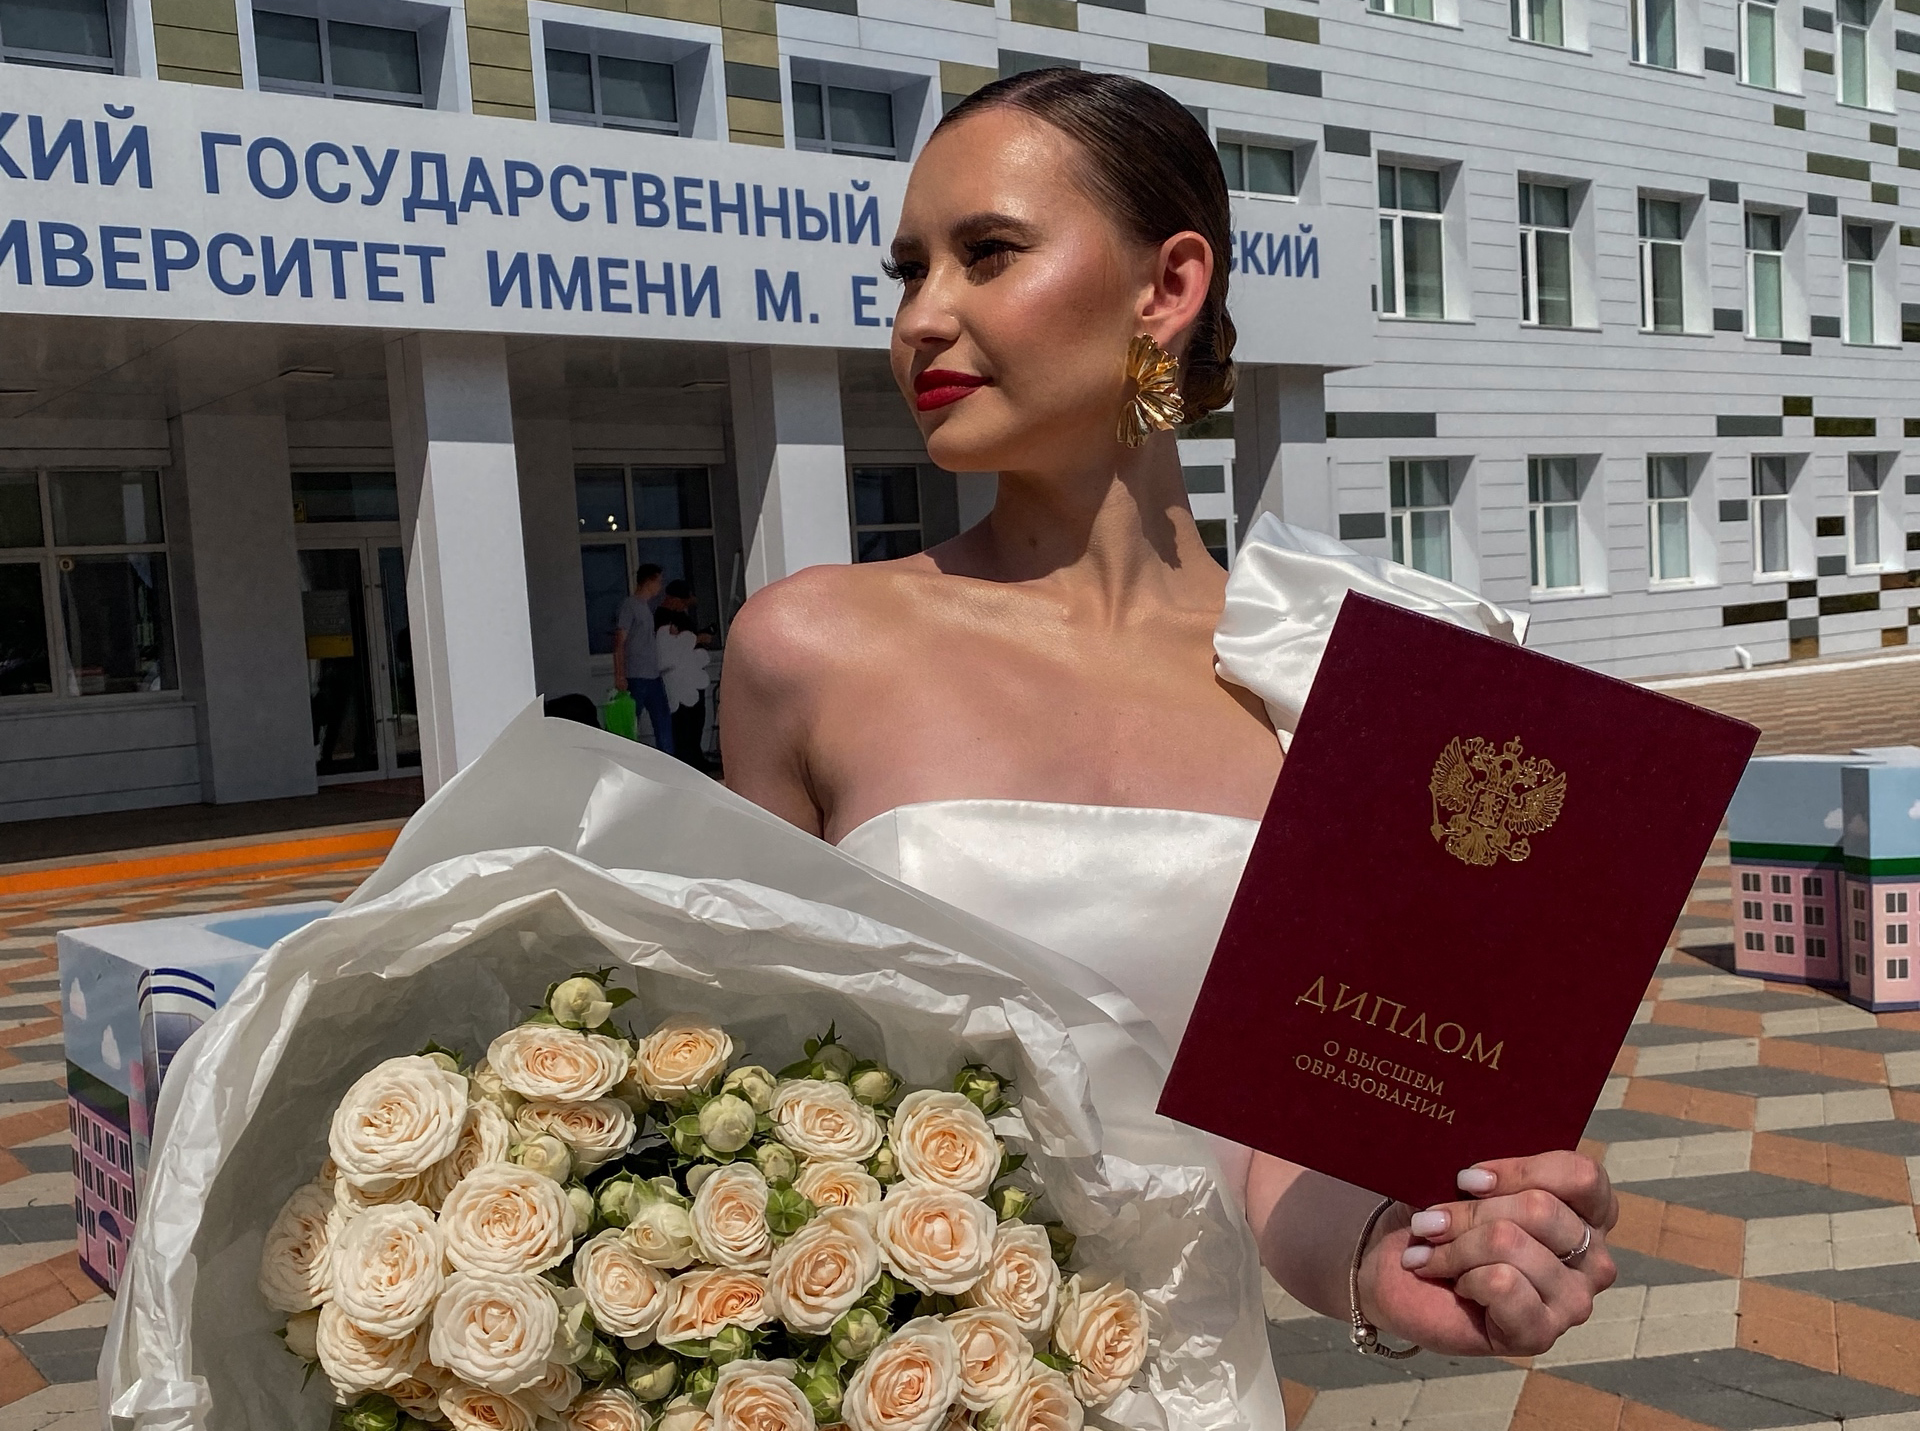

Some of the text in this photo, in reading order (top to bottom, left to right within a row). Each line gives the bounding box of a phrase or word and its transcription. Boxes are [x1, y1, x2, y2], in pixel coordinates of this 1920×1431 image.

[200, 131, 881, 247] ГОСУДАРСТВЕННЫЙ
[486, 250, 721, 319] ИМЕНИ
[754, 268, 820, 325] М.
[851, 275, 894, 328] Е.
[1295, 975, 1504, 1070] ДИПЛОМ
[1295, 1054, 1456, 1125] ОБРАЗОВАНИИ
[1323, 1040, 1445, 1096] О ВЫСШЕМ
